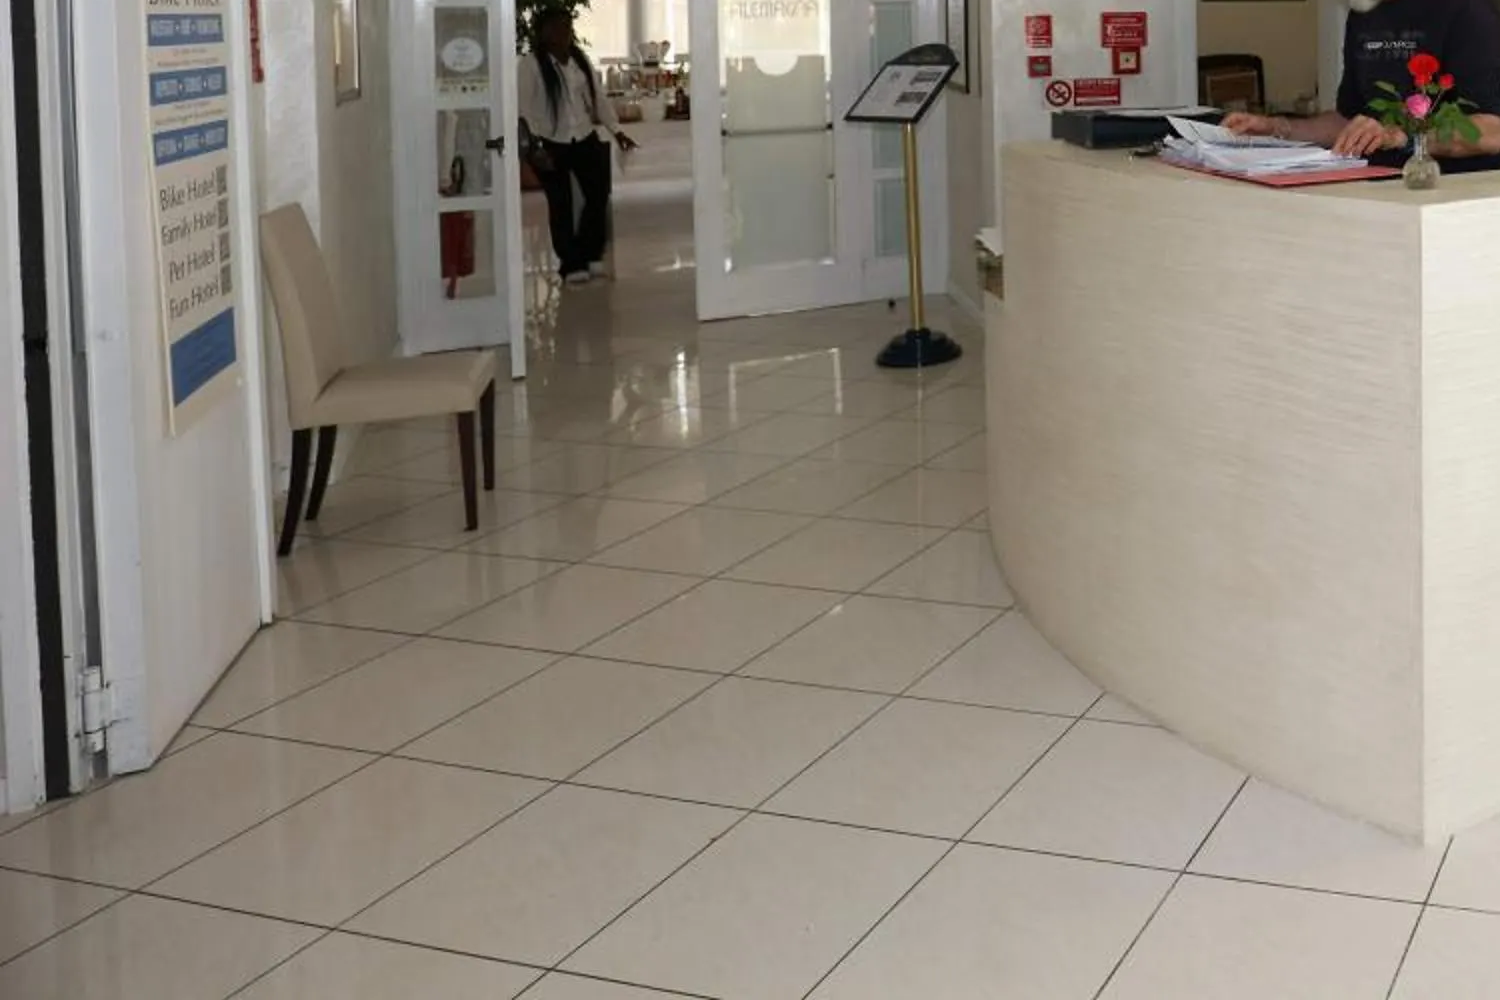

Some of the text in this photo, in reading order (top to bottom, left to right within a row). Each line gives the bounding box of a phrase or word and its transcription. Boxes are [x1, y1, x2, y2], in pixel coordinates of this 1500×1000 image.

[159, 170, 215, 211] Bike Hotel
[161, 215, 190, 246] Family
[169, 243, 215, 284] Pet Hotel
[169, 278, 219, 320] Fun Hotel
